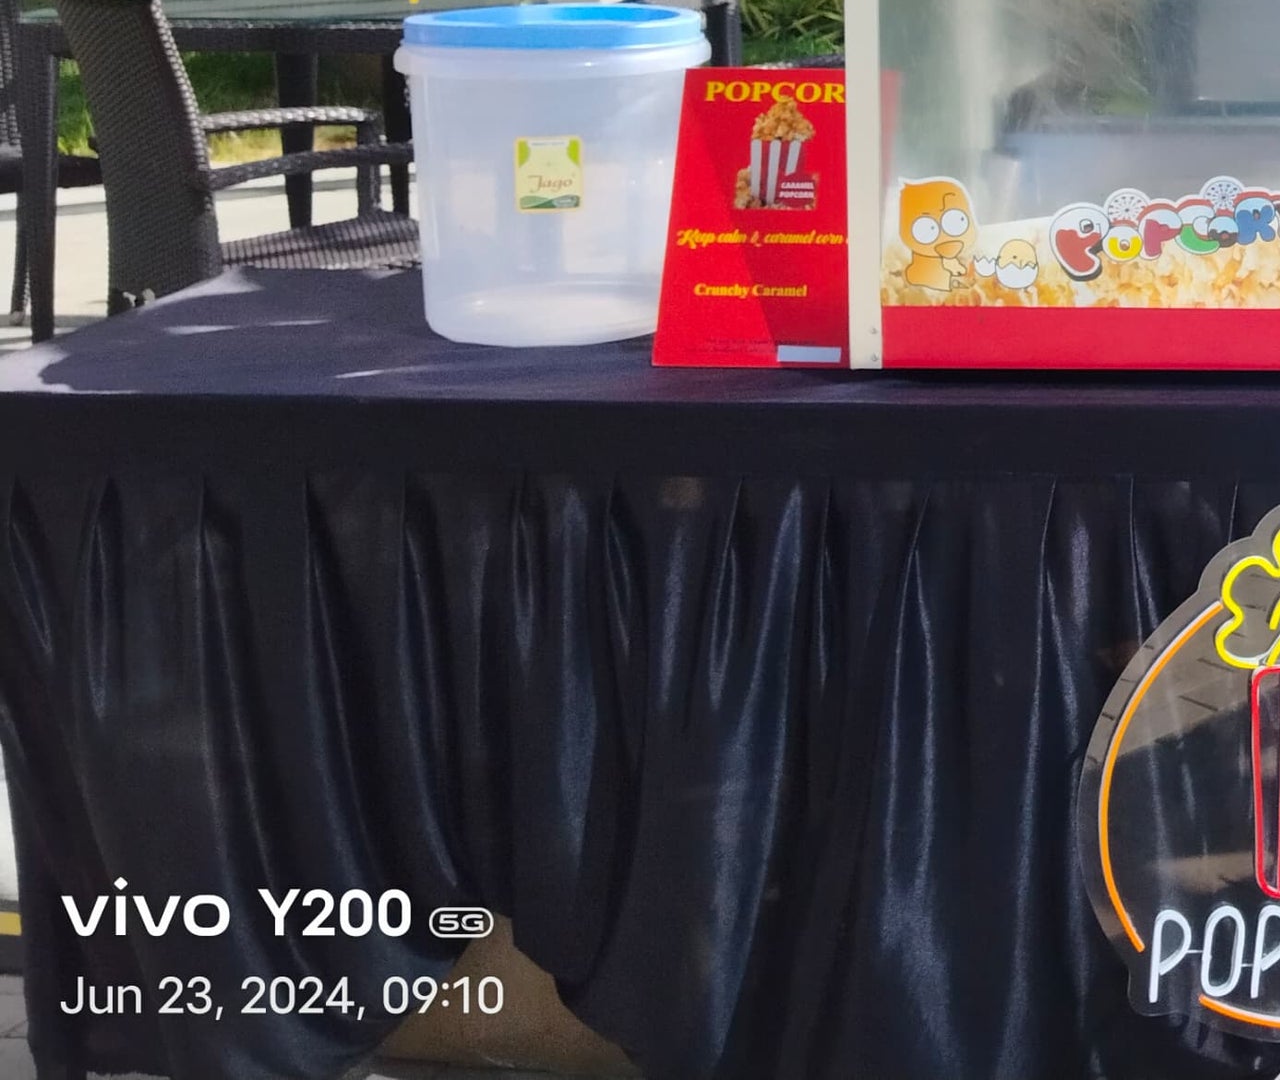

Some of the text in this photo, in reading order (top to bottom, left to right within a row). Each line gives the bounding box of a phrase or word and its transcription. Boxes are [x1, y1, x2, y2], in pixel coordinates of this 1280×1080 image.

[705, 80, 845, 103] POPCOR
[527, 175, 574, 193] Jago
[778, 191, 815, 199] POPCORN
[693, 283, 808, 299] Crunchy Caramel
